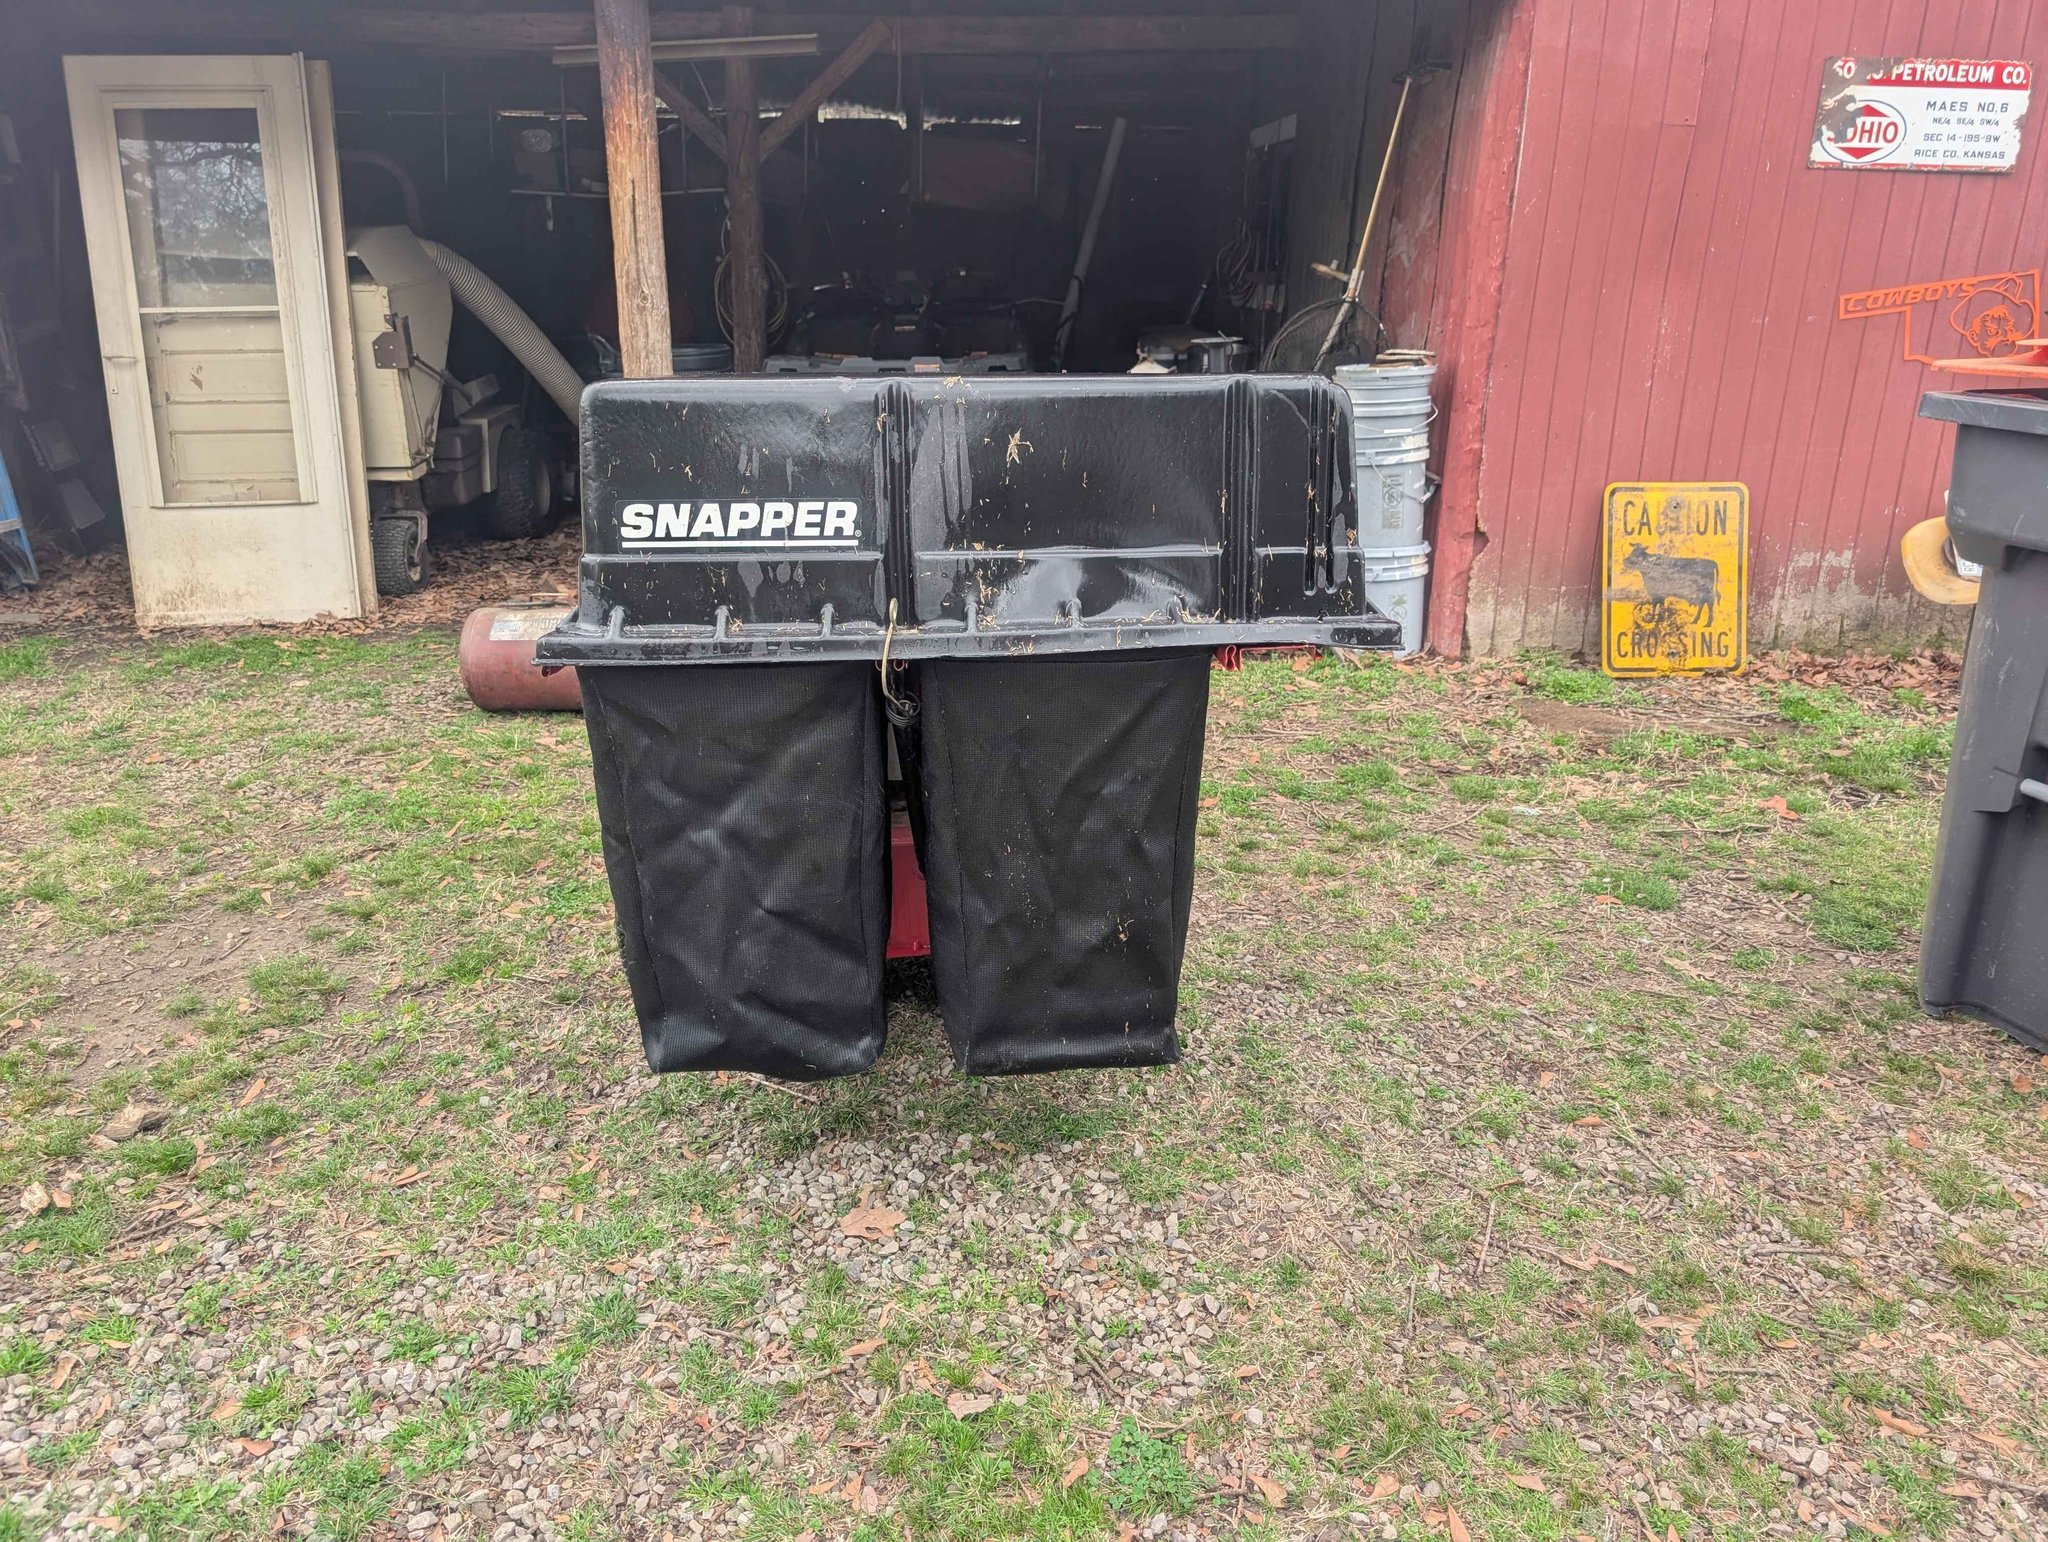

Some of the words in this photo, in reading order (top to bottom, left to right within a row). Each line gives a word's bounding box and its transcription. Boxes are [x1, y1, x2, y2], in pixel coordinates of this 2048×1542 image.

[1891, 63, 1995, 84] PETROLEUM
[2001, 66, 2027, 85] CO.
[1925, 100, 1969, 113] MAES
[1827, 120, 1899, 144] OHIO
[1931, 116, 1951, 126] NE/4
[1955, 117, 1975, 126] SE/4
[1979, 118, 2000, 127] SW/4
[1922, 132, 1944, 142] SEC
[1913, 148, 1939, 158] RICE
[1942, 149, 1960, 159] CO.
[1962, 150, 2006, 160] KANSAS
[1846, 280, 1978, 312] COWBOYS
[620, 501, 859, 539] SNAPPER
[1622, 499, 1728, 537] CAION
